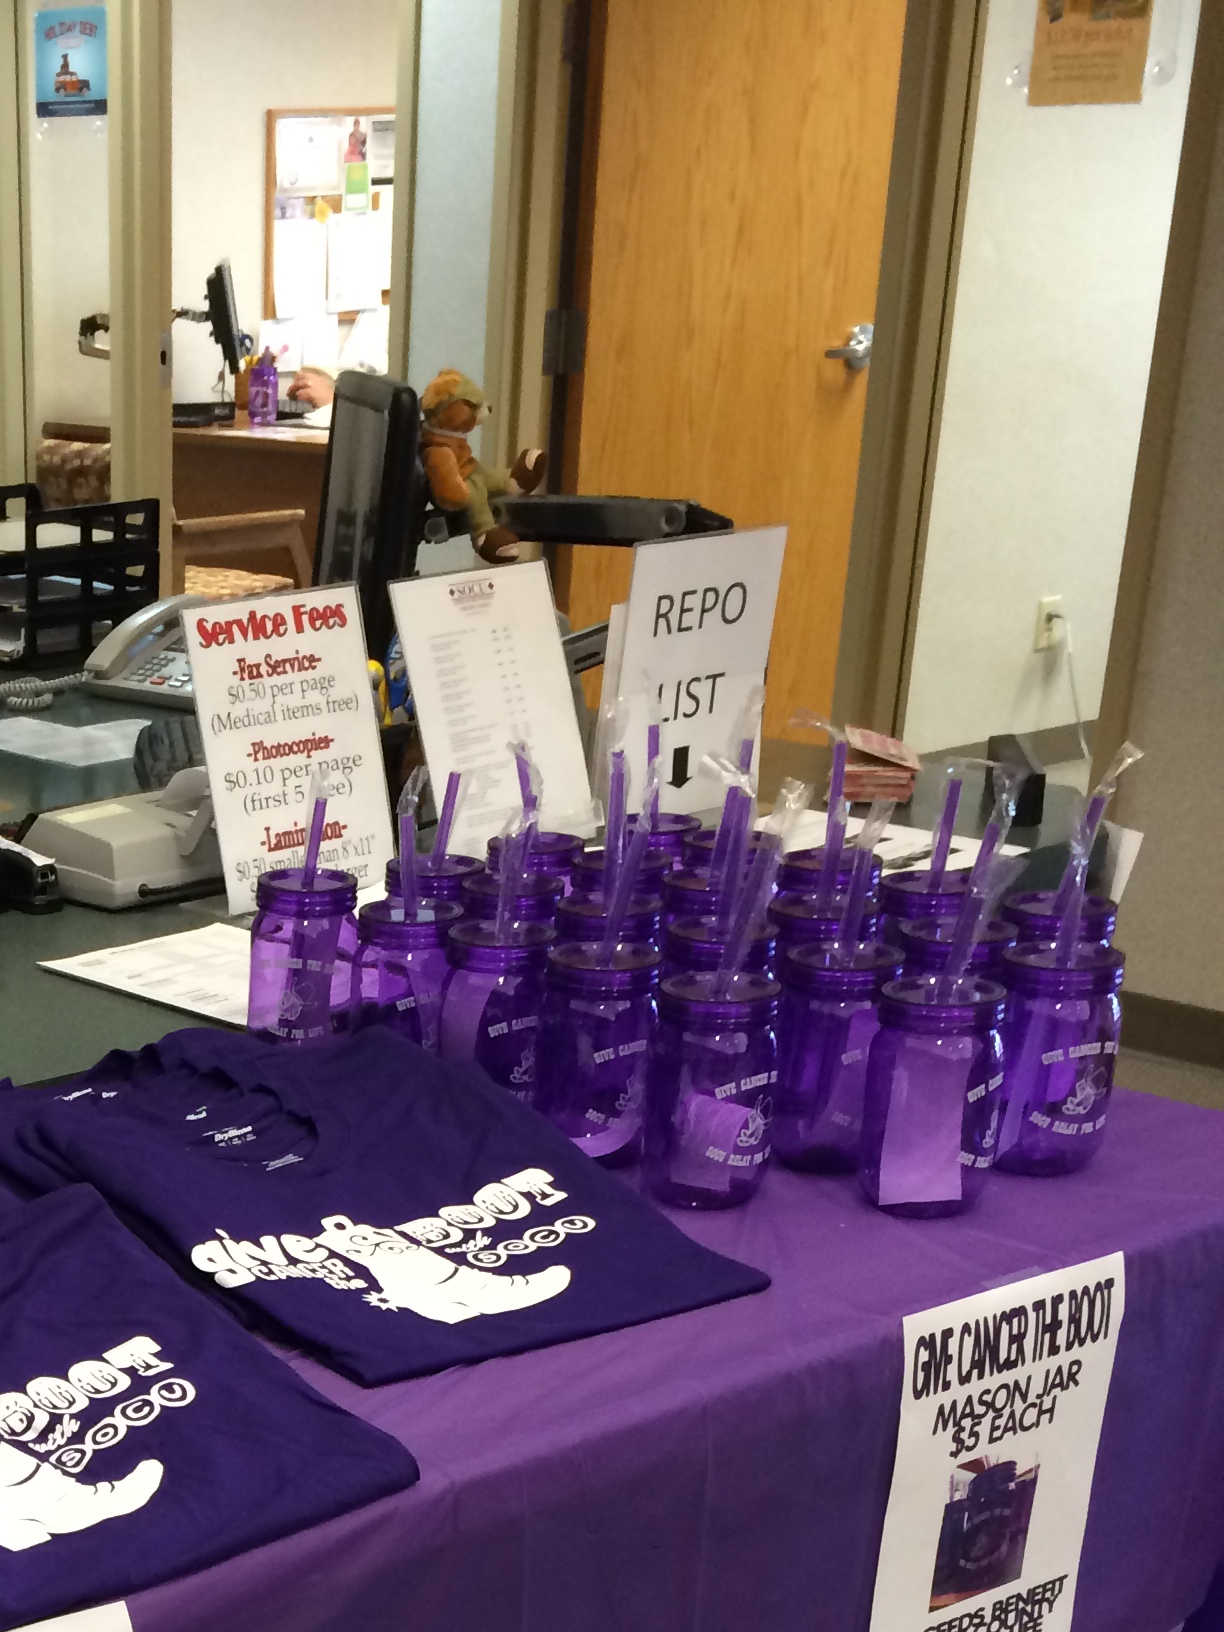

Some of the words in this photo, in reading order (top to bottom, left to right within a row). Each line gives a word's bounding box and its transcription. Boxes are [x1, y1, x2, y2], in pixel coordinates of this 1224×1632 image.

[196, 610, 288, 649] Service
[291, 603, 348, 634] Fees
[653, 582, 747, 637] REPO
[232, 657, 263, 681] -Fax
[264, 649, 322, 678] Service-
[227, 681, 266, 705] $0.50
[270, 684, 295, 703] per
[300, 674, 335, 698] page
[657, 672, 726, 722] LIST
[211, 703, 276, 738] (Medical
[281, 701, 322, 721] items
[326, 691, 359, 714] free)
[247, 732, 334, 762] -Photocopies-
[224, 766, 274, 792] $0.10
[280, 763, 312, 786] per
[317, 754, 363, 776] page
[243, 789, 290, 816] (first
[294, 784, 305, 804] 5
[269, 850, 306, 872] smalle
[316, 847, 339, 864] han
[394, 1168, 568, 1247] BOOT
[191, 1227, 329, 1289] give
[467, 1215, 596, 1268] SOCU
[250, 1258, 356, 1281] CANCER
[325, 1276, 369, 1291] the
[912, 1327, 954, 1400] GIVE
[957, 1304, 1029, 1387] CANCER
[1031, 1293, 1065, 1364] THE
[1065, 1277, 1115, 1352] BOOT
[932, 1375, 1032, 1436] MASON
[1035, 1359, 1083, 1399] JAR
[29, 1414, 81, 1454] with
[48, 1377, 196, 1473] SOCU
[949, 1420, 982, 1459] $5
[987, 1395, 1057, 1445] EACH
[991, 1573, 1069, 1619] BENEFIT
